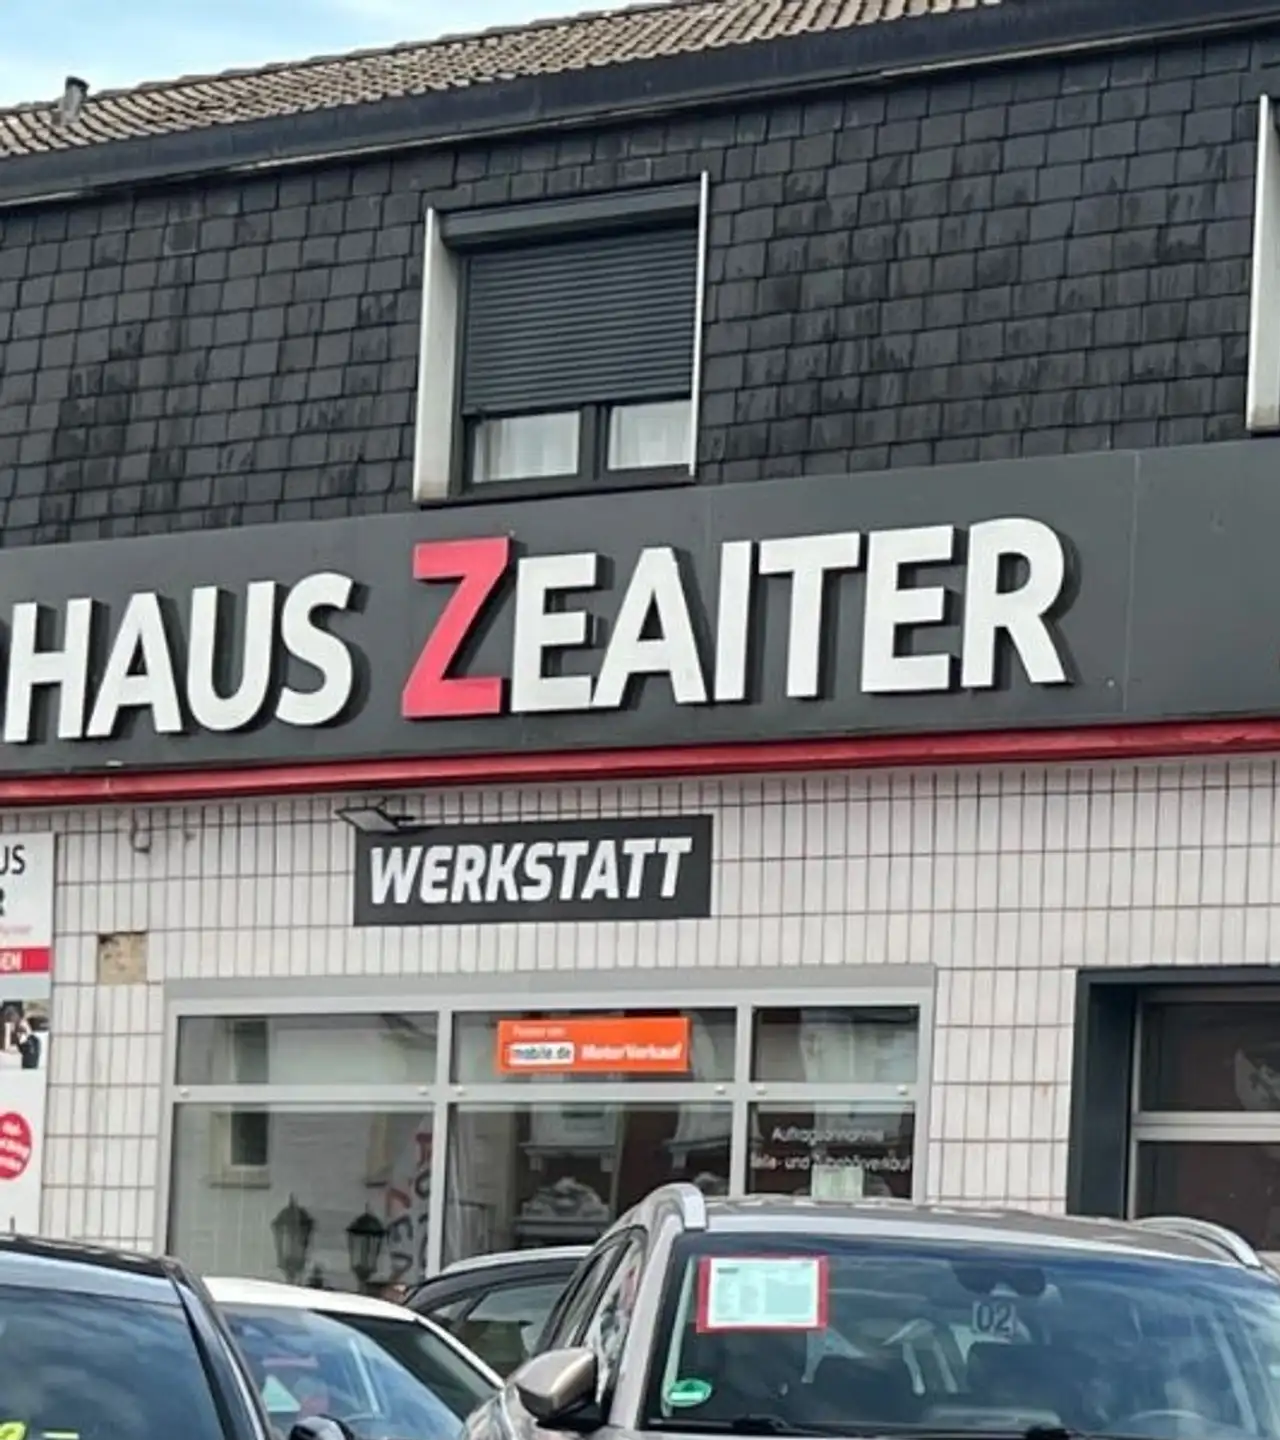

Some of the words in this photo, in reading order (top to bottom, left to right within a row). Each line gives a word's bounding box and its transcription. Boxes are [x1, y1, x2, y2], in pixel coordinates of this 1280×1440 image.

[4, 572, 356, 743] HAUS
[402, 517, 1067, 719] ZEAITER
[369, 835, 694, 906] WERKSTATT
